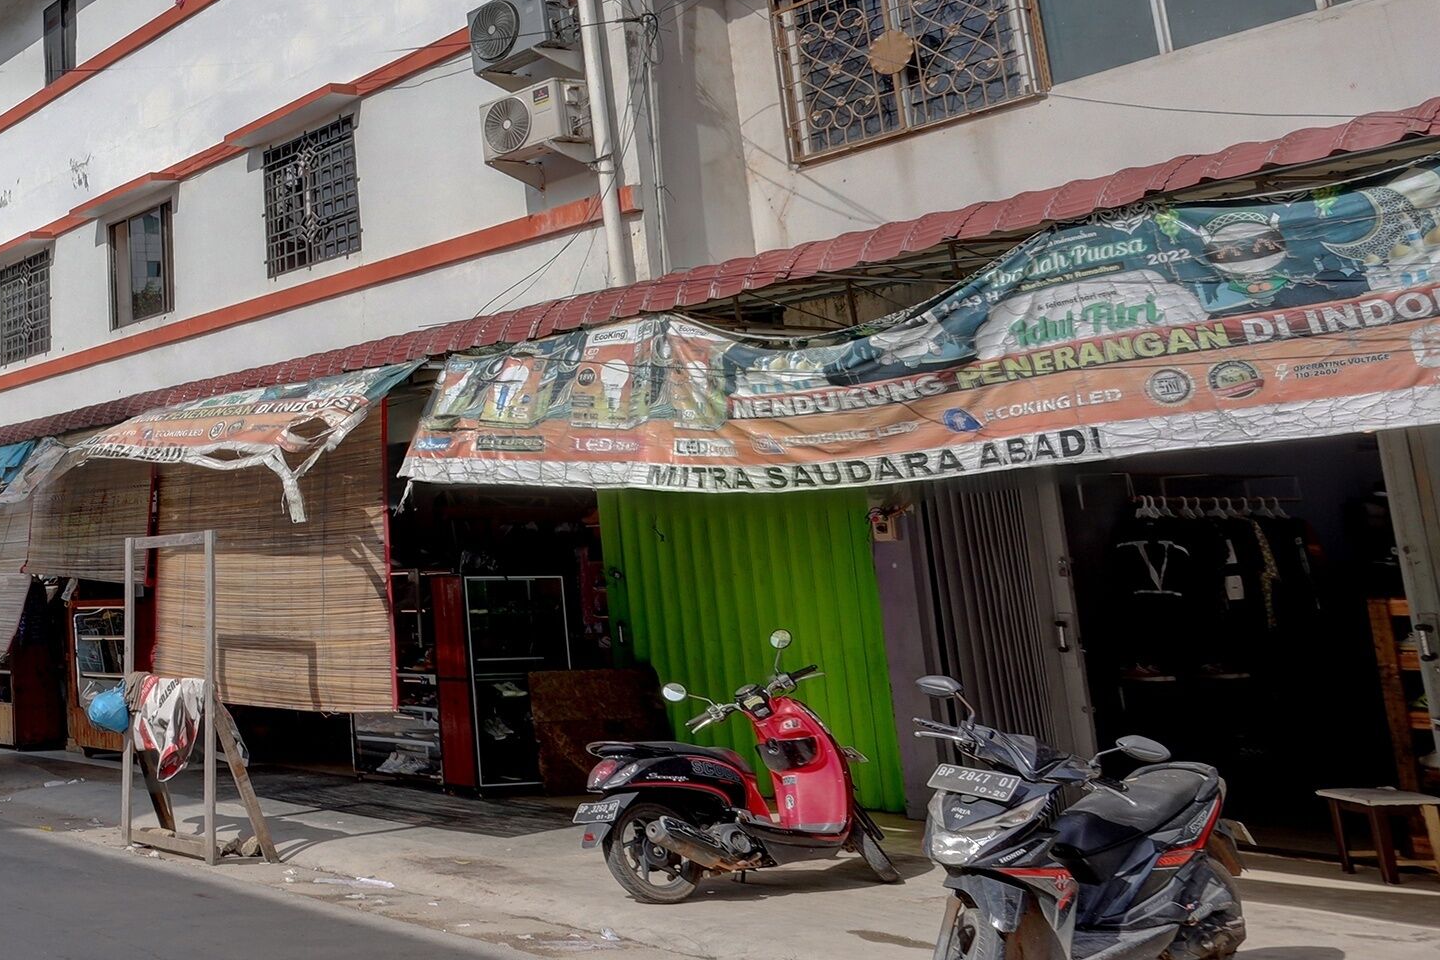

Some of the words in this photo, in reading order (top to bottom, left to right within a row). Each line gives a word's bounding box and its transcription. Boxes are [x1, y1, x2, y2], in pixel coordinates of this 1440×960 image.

[1070, 237, 1148, 265] Puasa
[1147, 249, 1193, 265] 2022
[1082, 292, 1165, 333] Fitri
[594, 330, 627, 341] EcoKing
[732, 374, 948, 419] MENDUKUNG
[956, 322, 1230, 390] PENERANGAN
[1242, 314, 1293, 344] DI
[1293, 359, 1346, 373] OPERATING
[1348, 353, 1389, 365] VOLTAGE
[985, 393, 1071, 423] ECOKING
[1077, 388, 1123, 407] LED
[647, 465, 754, 489] MITRA
[766, 448, 965, 489] SAUDARA
[980, 426, 1102, 469] ABADI
[937, 766, 955, 777] BP
[958, 770, 991, 784] 2847
[578, 805, 588, 814] BP
[998, 848, 1027, 864] HONDA
